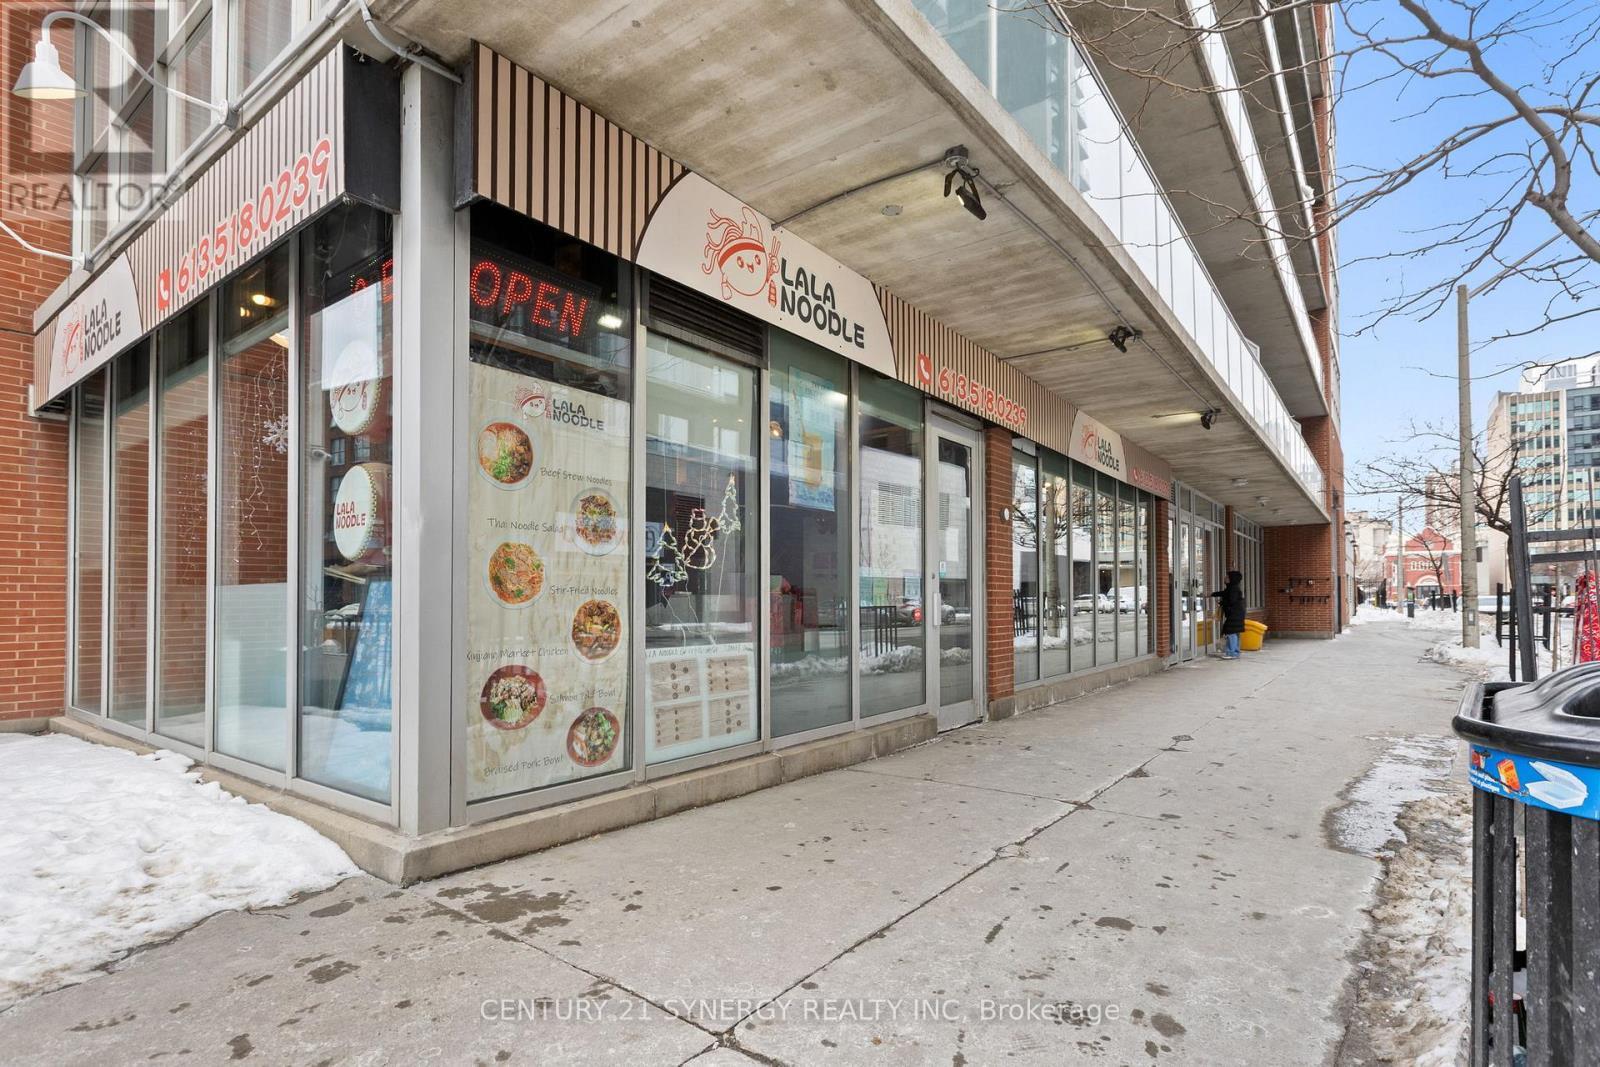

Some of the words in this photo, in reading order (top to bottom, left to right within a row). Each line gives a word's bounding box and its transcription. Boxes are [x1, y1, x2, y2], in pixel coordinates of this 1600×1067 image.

[178, 139, 331, 294] 613.518.0239
[781, 258, 836, 308] LALA
[469, 260, 589, 338] OPEN
[84, 298, 107, 336] LALA
[781, 292, 865, 349] NOODLE
[84, 310, 121, 361] NOODLE
[553, 399, 585, 414] LALA
[939, 367, 1027, 426] 613.518.0239
[552, 409, 605, 431] NOODLE
[1097, 436, 1112, 455] LALA
[1097, 450, 1120, 472] NOODLE
[540, 467, 561, 479] Beef
[586, 475, 613, 486] Noodles
[336, 501, 355, 515] LALA
[335, 513, 366, 529] NOODLE
[487, 517, 508, 529] Thai
[510, 521, 540, 532] Noodle
[591, 586, 618, 596] Noodles
